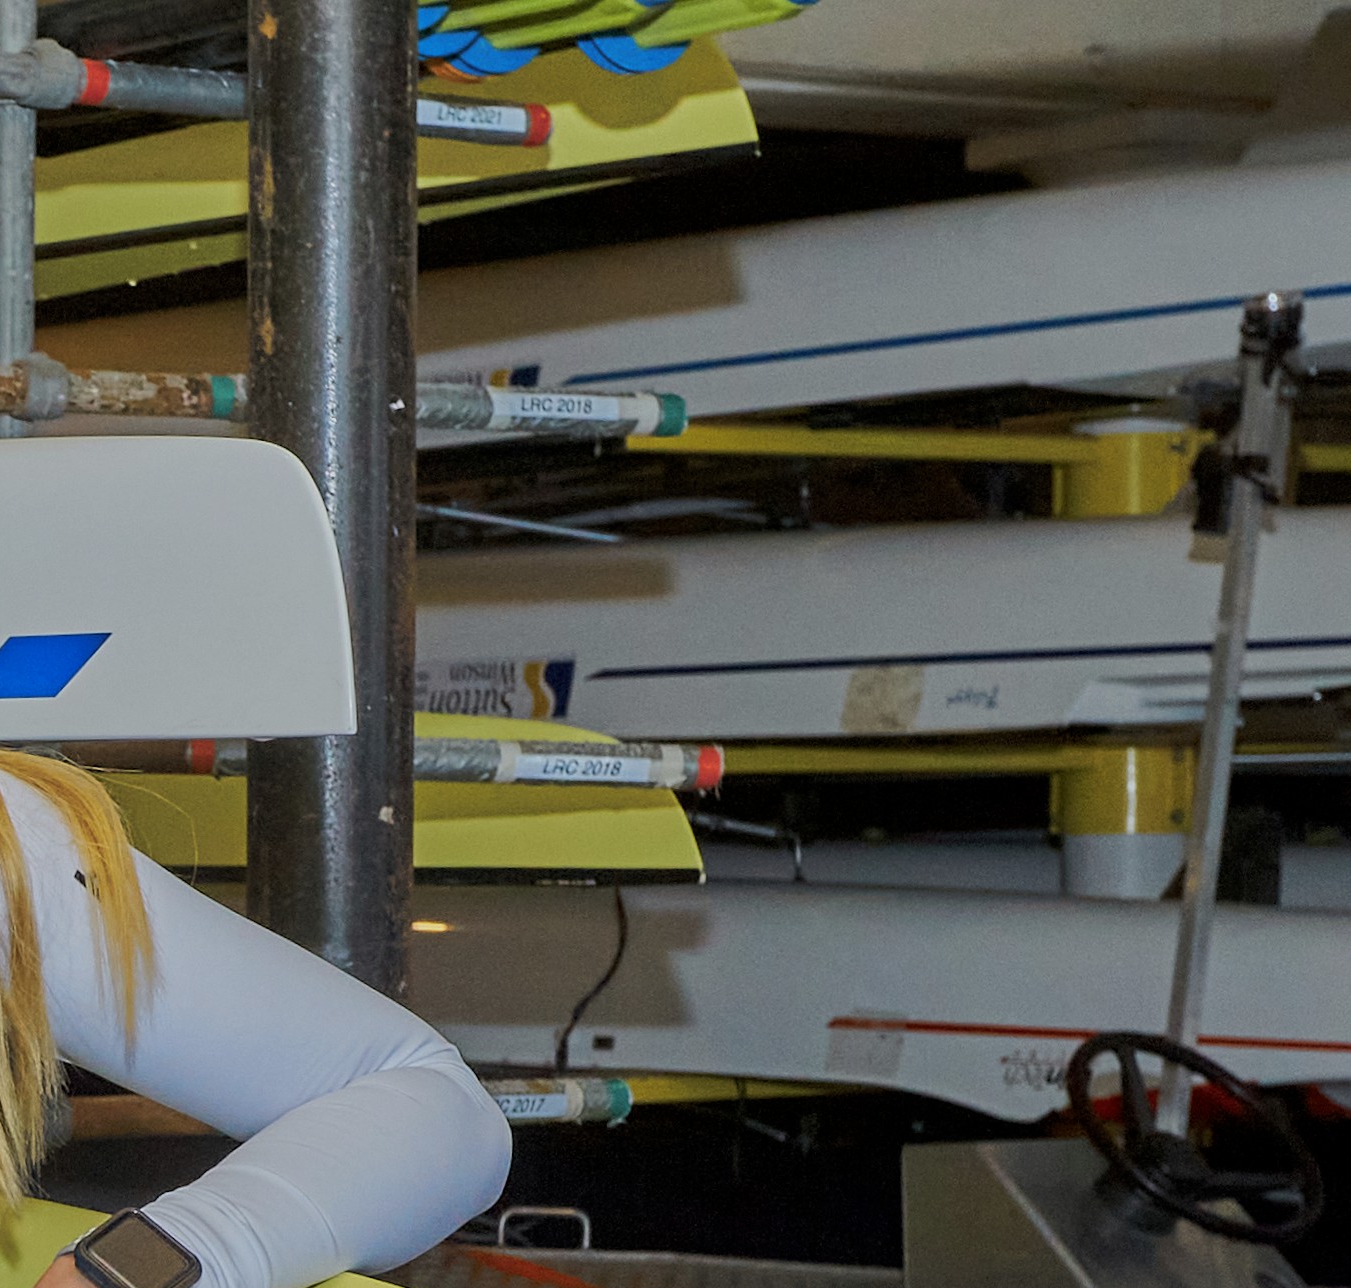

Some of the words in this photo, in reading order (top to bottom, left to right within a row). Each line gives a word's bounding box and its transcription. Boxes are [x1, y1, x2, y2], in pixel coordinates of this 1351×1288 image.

[438, 105, 466, 121] LRC
[521, 397, 553, 412] LRC
[557, 399, 592, 414] 2018
[542, 759, 578, 776] LRC
[582, 760, 622, 777] 2018
[513, 1098, 546, 1114] 2017
